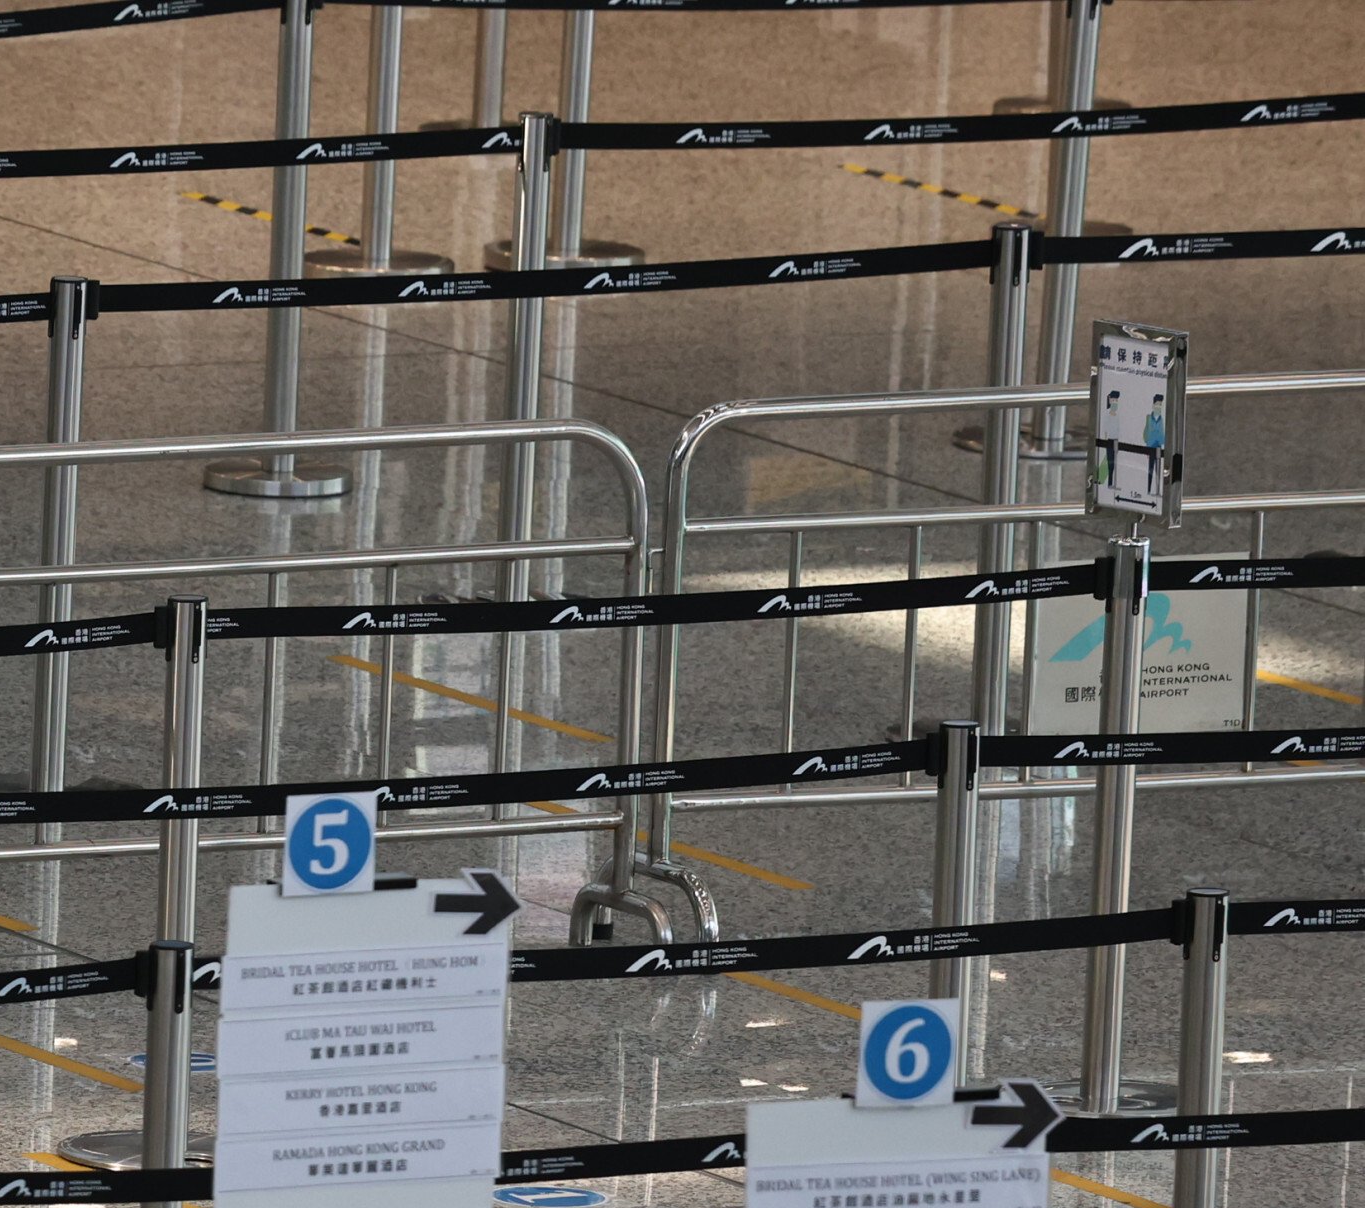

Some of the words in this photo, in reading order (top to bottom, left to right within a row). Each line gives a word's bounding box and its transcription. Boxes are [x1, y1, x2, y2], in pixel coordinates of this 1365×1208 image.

[1178, 663, 1210, 672] KONG
[1141, 674, 1232, 686] NTERNATIONAL
[1140, 688, 1189, 698] AIRPORT
[309, 808, 350, 876] 5
[885, 1017, 931, 1084] 6
